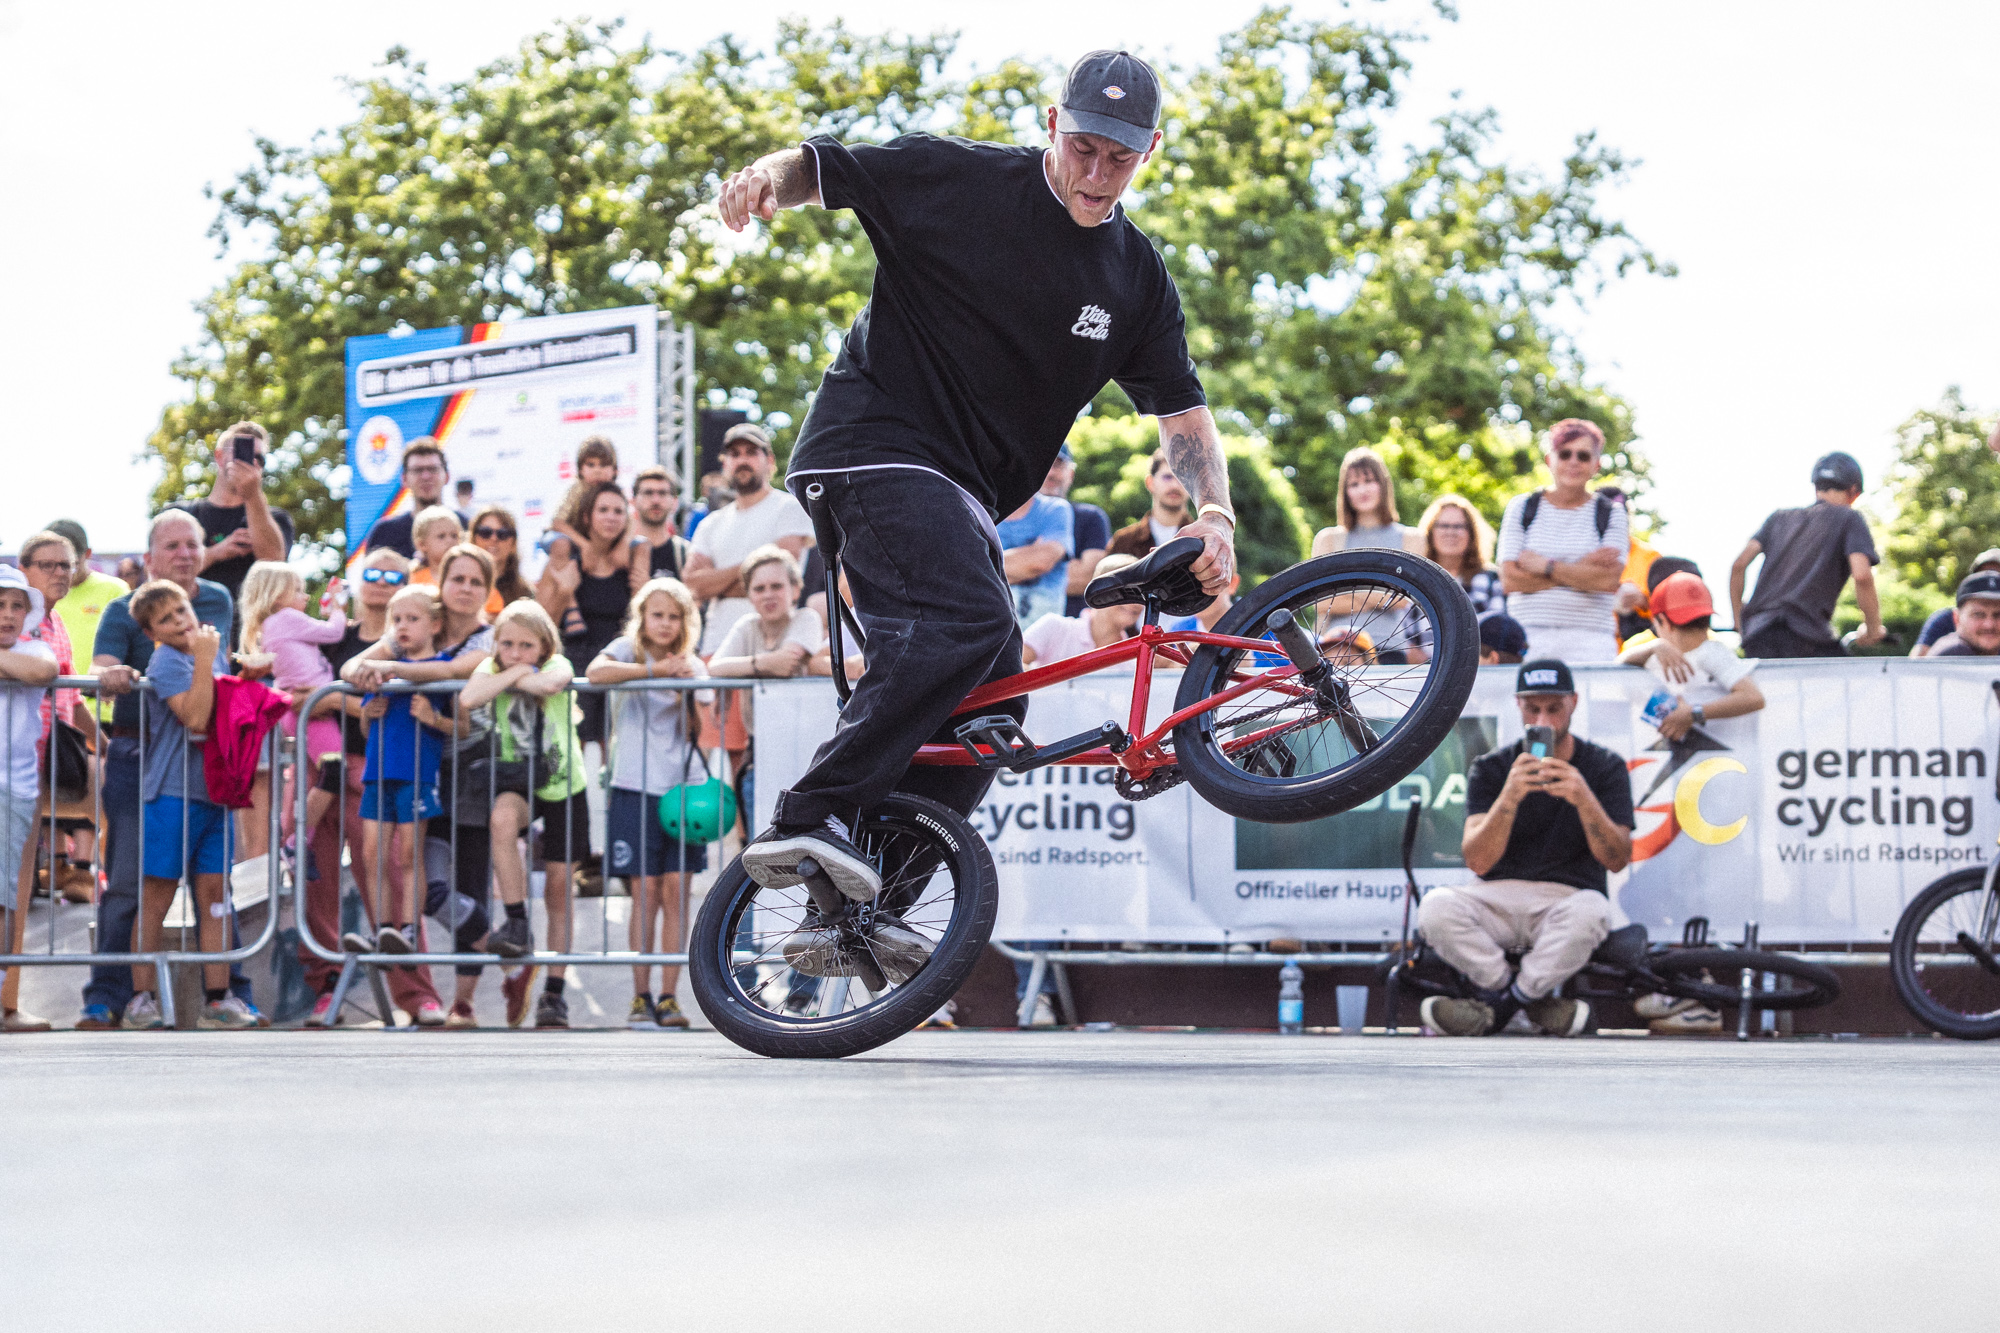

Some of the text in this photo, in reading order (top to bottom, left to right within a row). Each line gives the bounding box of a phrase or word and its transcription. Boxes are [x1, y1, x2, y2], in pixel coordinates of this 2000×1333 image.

[1078, 304, 1112, 324] Vita
[1071, 321, 1110, 341] Cola
[997, 766, 1116, 787] erma
[1776, 748, 1987, 790] german
[1776, 786, 1974, 837] cycling
[999, 847, 1150, 868] sind Radsport.
[1776, 843, 1988, 865] Wir sind Radsport.
[1235, 881, 1339, 900] Offizieller
